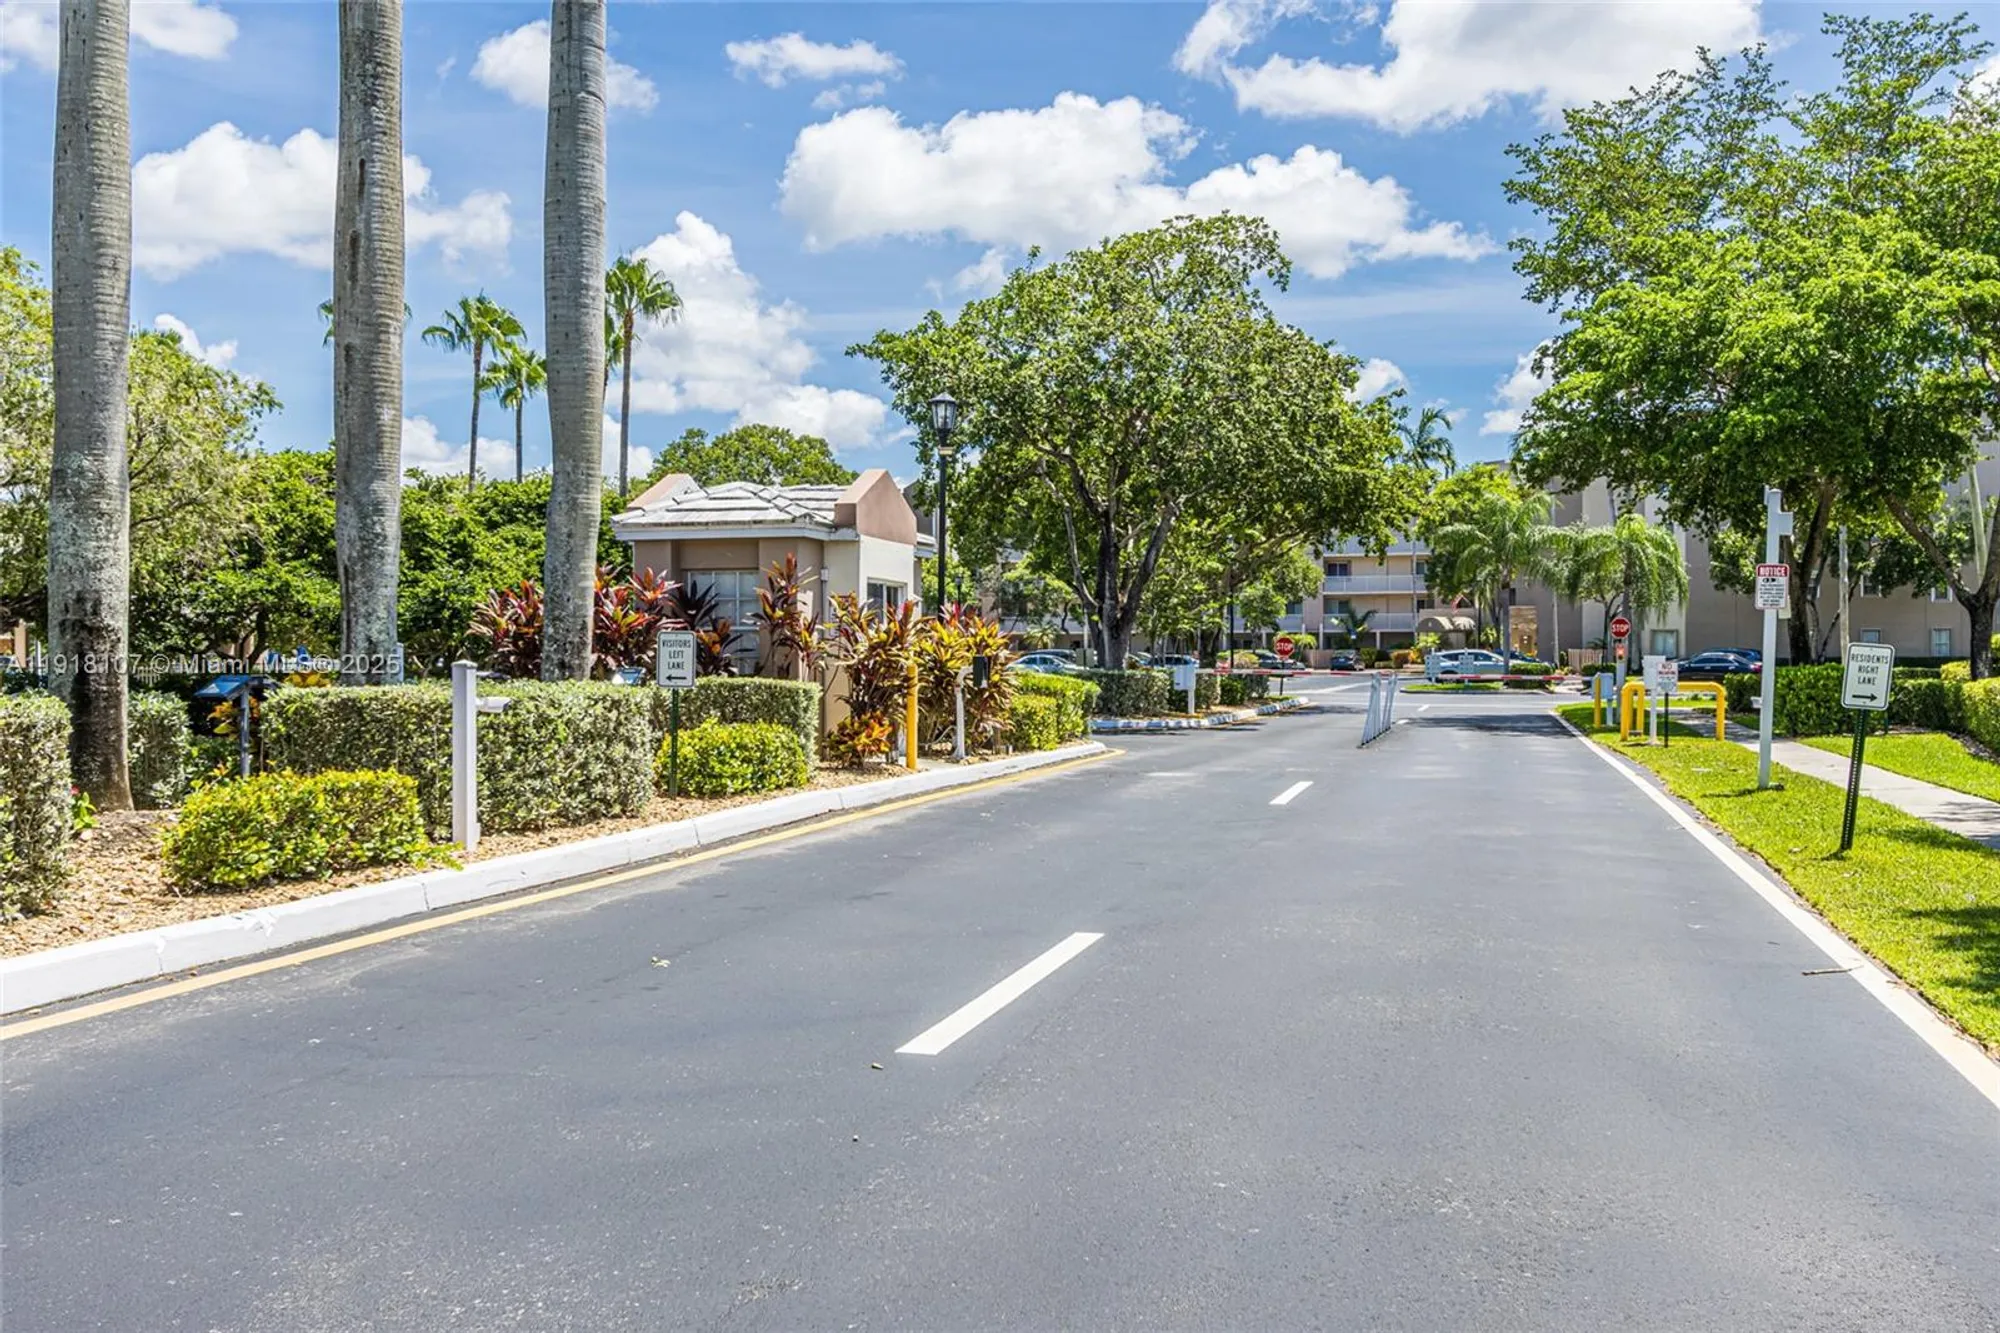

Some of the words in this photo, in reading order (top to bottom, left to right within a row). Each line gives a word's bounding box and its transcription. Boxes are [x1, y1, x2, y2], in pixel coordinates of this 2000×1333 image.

[1760, 566, 1786, 576] NOTICE
[1612, 623, 1629, 632] STOP
[662, 640, 691, 648] VISITORS
[1276, 642, 1293, 651] STOP
[669, 650, 684, 659] LEFT
[1850, 653, 1889, 664] RESIDENTS
[667, 661, 685, 670] LANE
[1858, 664, 1879, 674] RIGHT
[1858, 676, 1877, 685] LANE
